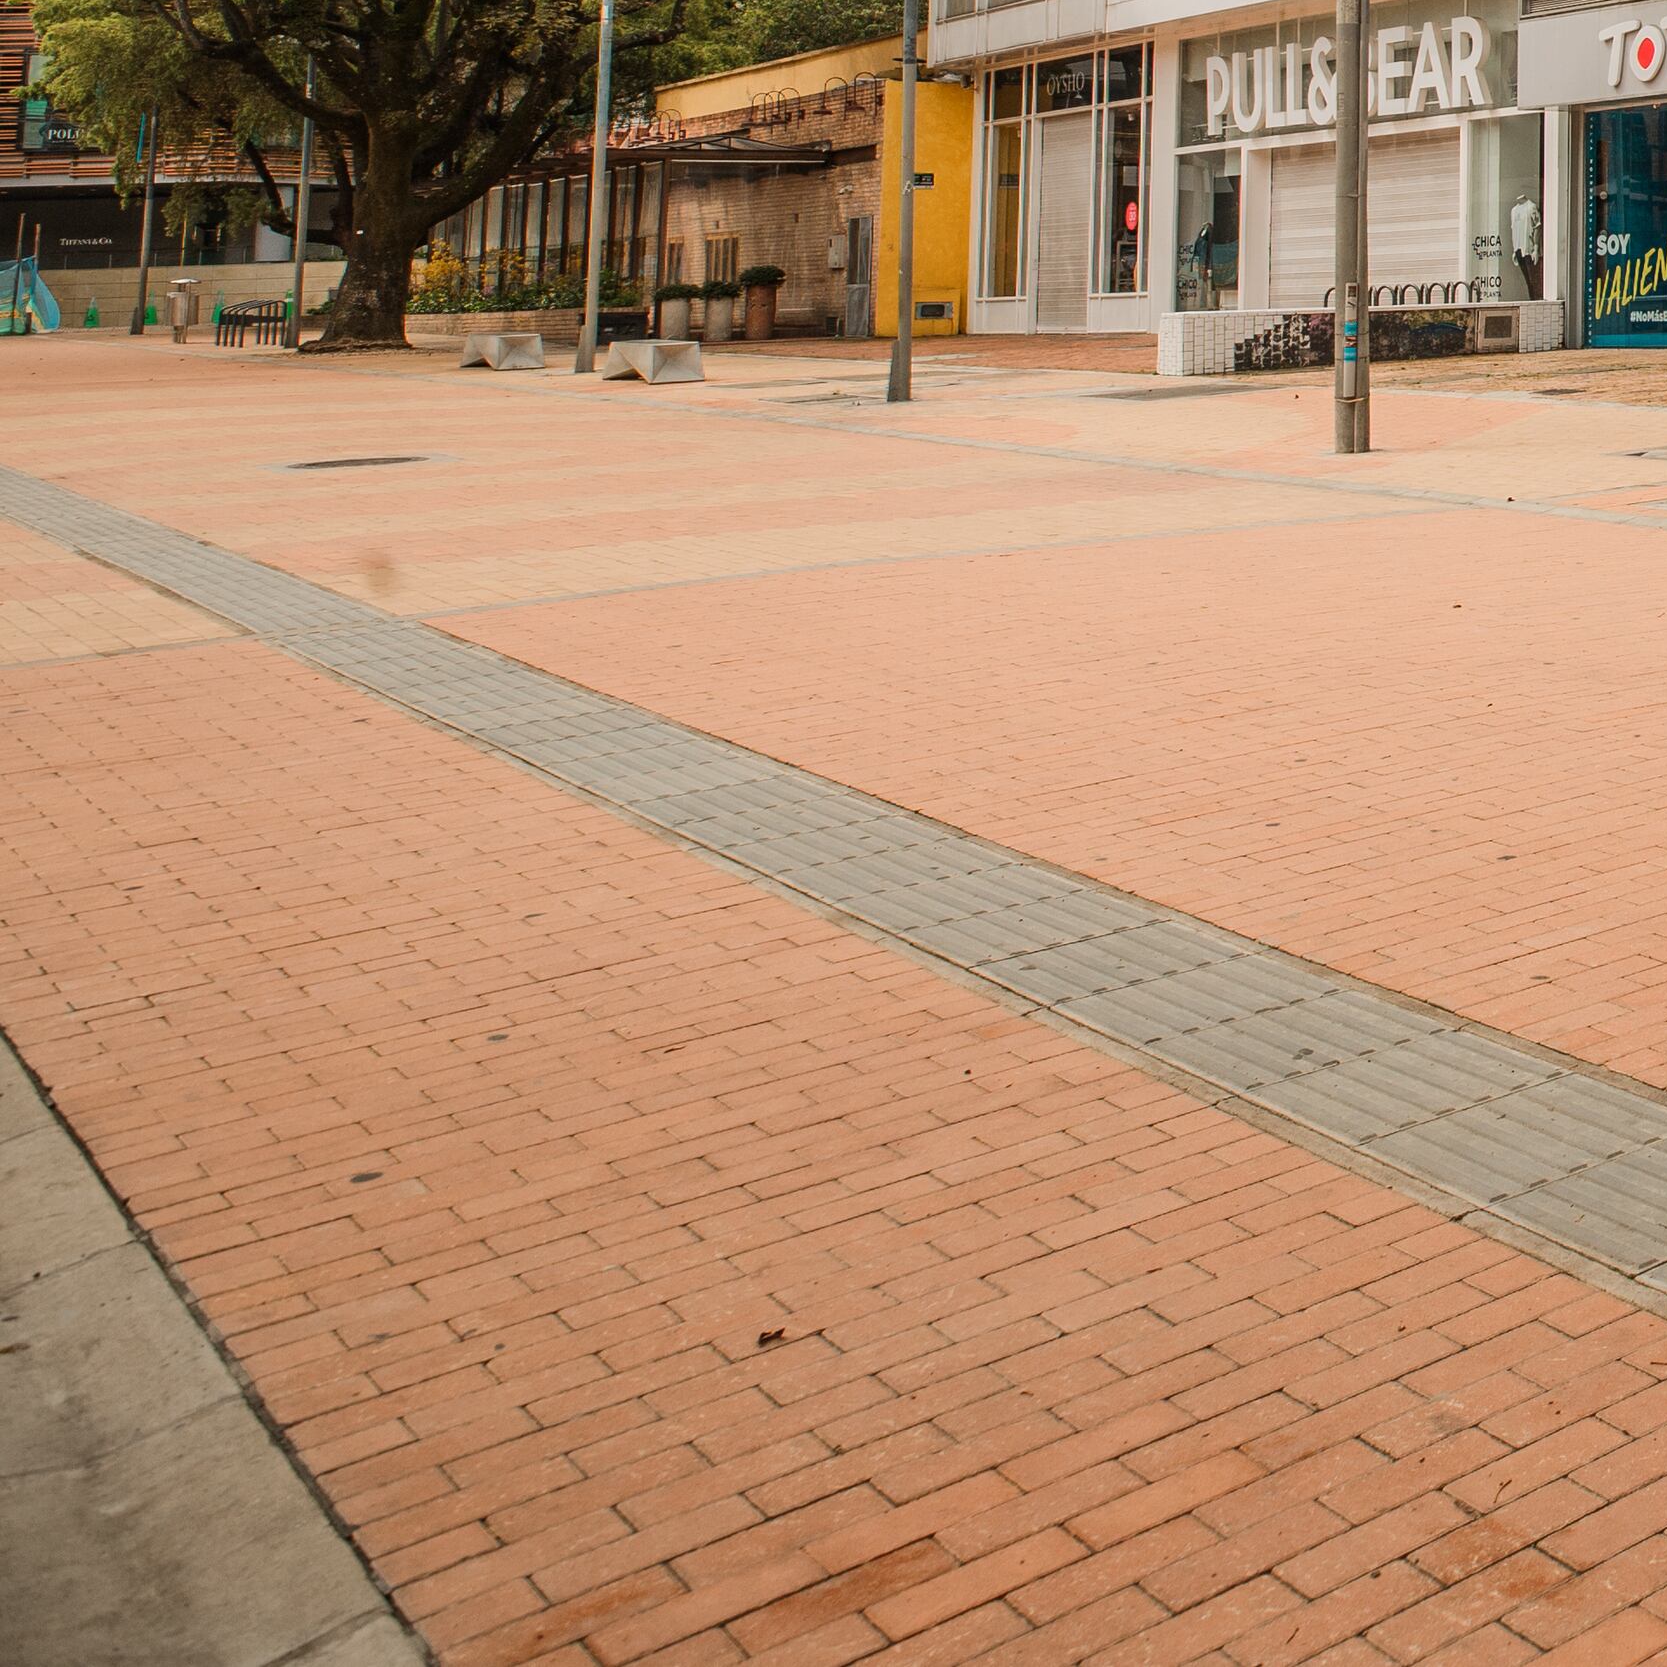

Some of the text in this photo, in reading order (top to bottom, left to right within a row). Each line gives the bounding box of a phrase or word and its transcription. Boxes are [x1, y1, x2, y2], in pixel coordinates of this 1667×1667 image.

[1047, 72, 1085, 95] OYSHO
[1206, 16, 1492, 136] PULL&EAR
[47, 128, 81, 140] POL
[1475, 235, 1502, 247] CHICA
[1596, 234, 1630, 256] SOY
